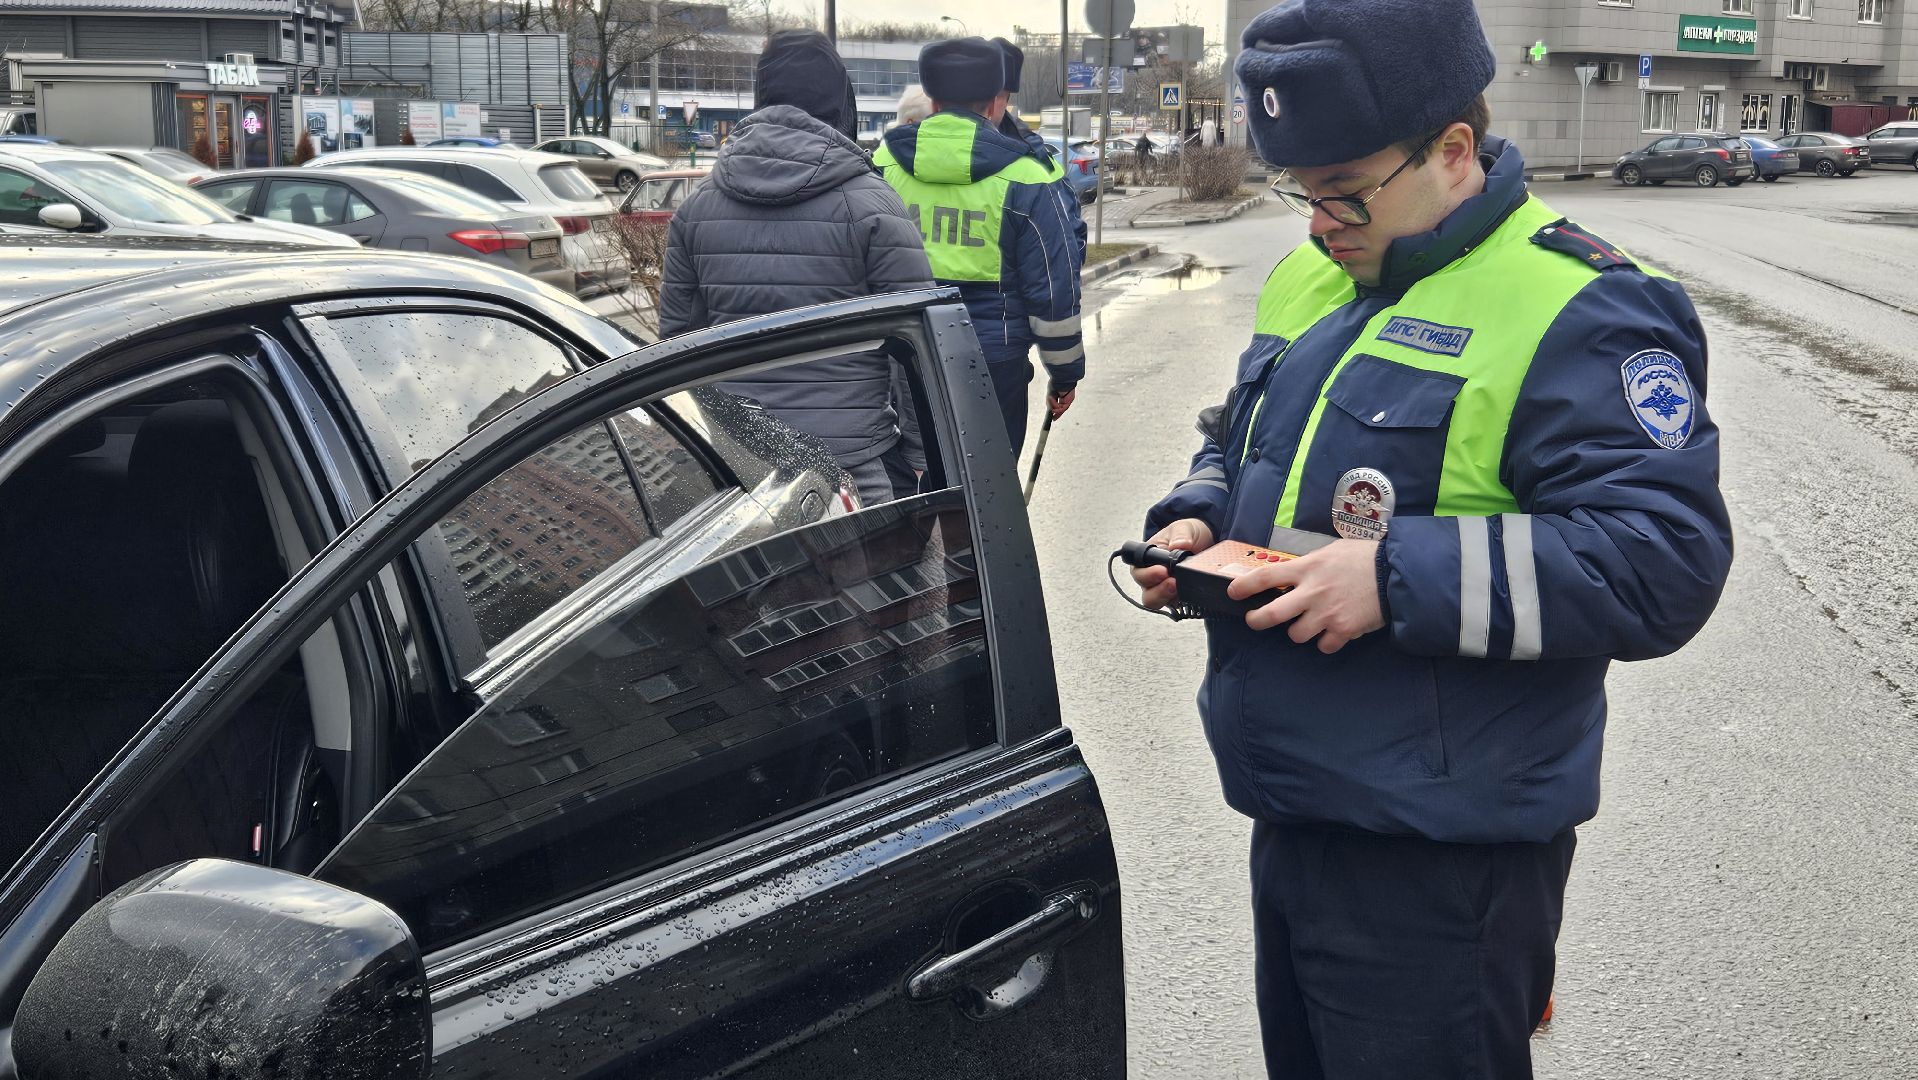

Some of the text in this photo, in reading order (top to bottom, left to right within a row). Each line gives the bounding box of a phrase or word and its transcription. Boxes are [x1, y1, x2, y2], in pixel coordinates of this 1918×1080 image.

[205, 63, 260, 86] ТАБАК
[1233, 110, 1242, 119] 20
[1385, 321, 1417, 337] ДПС
[1659, 430, 1684, 447] МВД
[1343, 471, 1390, 496] МВД РОССИИ
[1339, 512, 1381, 531] ПОЛИЦИЯ
[1340, 523, 1375, 539] 002394
